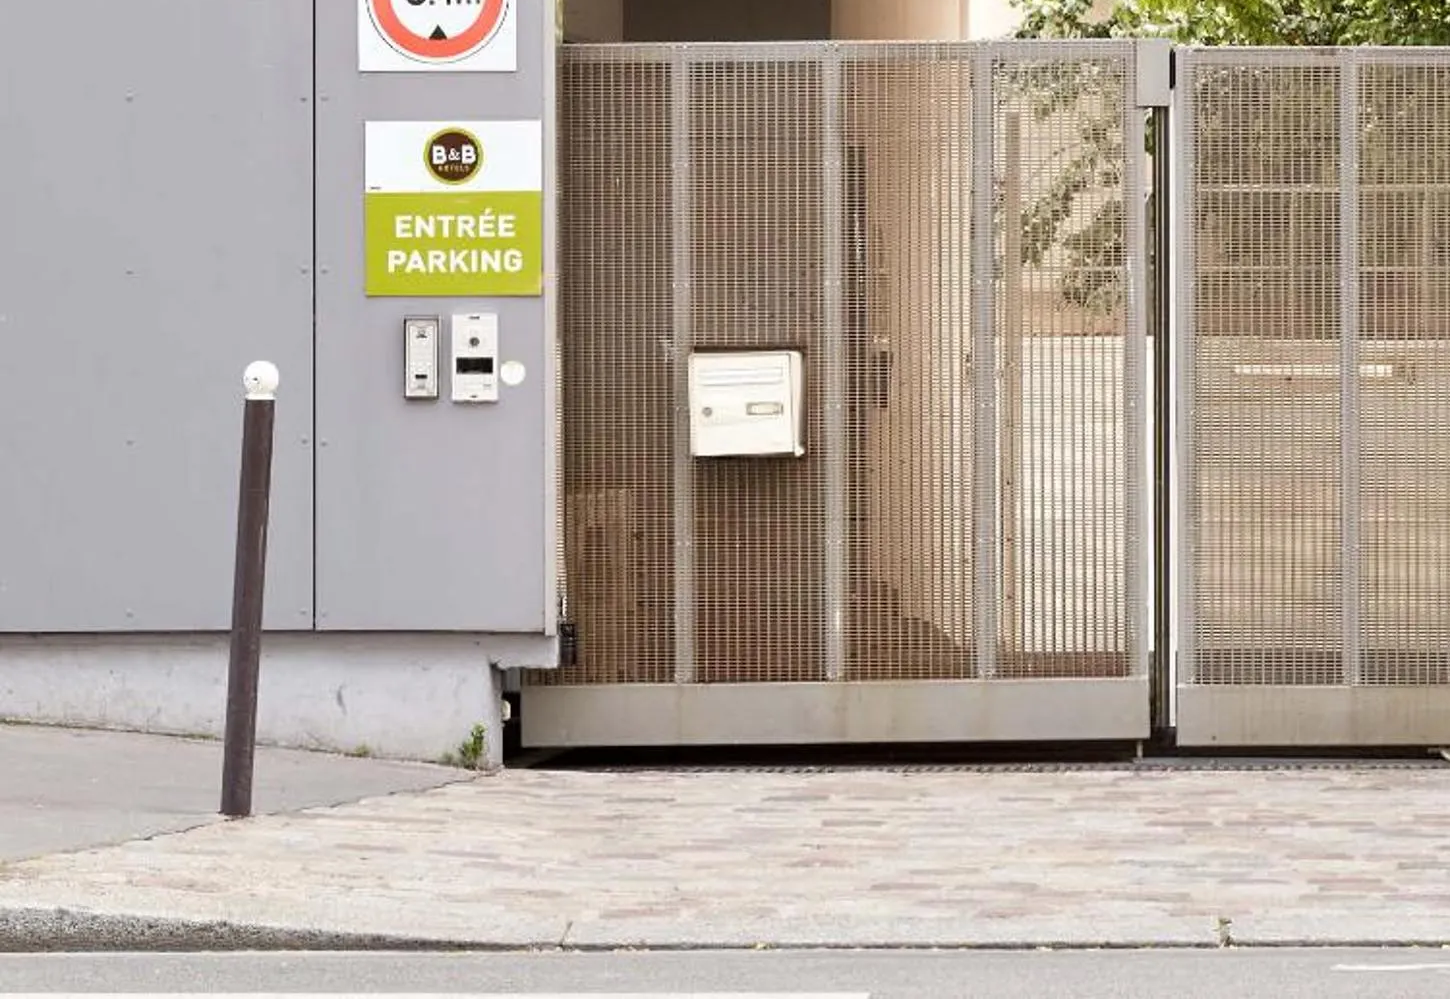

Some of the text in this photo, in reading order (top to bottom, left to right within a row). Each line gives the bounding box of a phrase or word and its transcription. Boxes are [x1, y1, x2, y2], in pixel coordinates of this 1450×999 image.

[432, 144, 477, 165] B&B
[394, 208, 517, 238] ENTRÉE
[387, 249, 524, 274] PARKING
